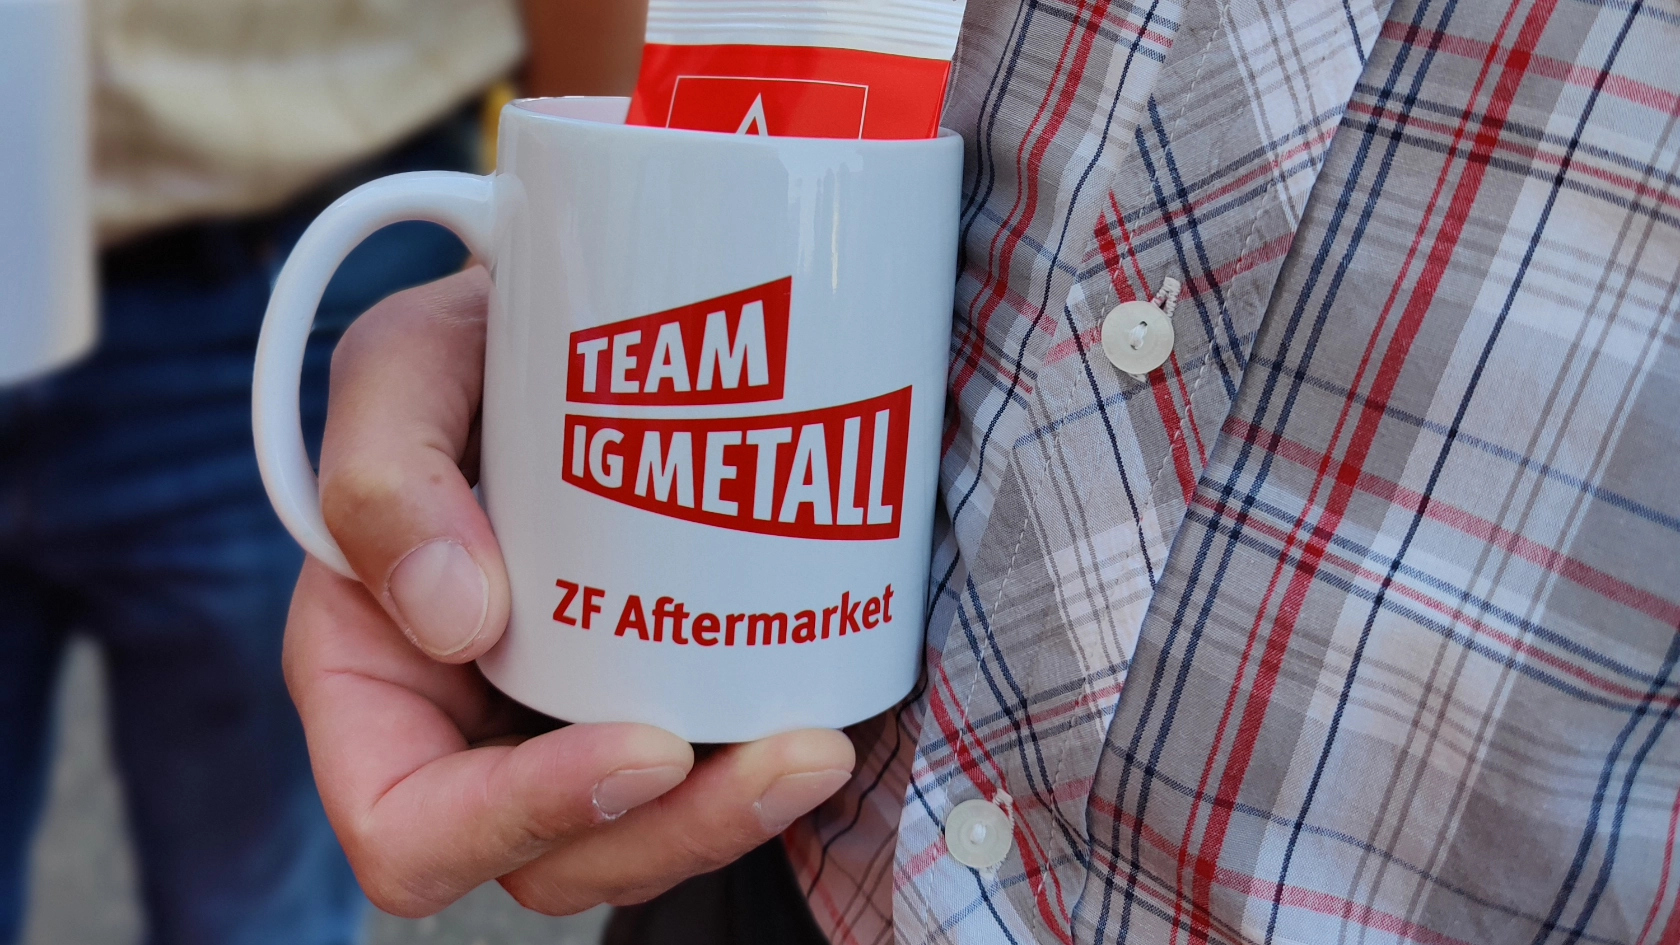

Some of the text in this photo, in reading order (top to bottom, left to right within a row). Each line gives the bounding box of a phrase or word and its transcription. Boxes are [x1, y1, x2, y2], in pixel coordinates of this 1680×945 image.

[576, 300, 769, 393] TEAM
[571, 408, 893, 526] IG METALL
[552, 578, 895, 647] ZF Aftermarket
